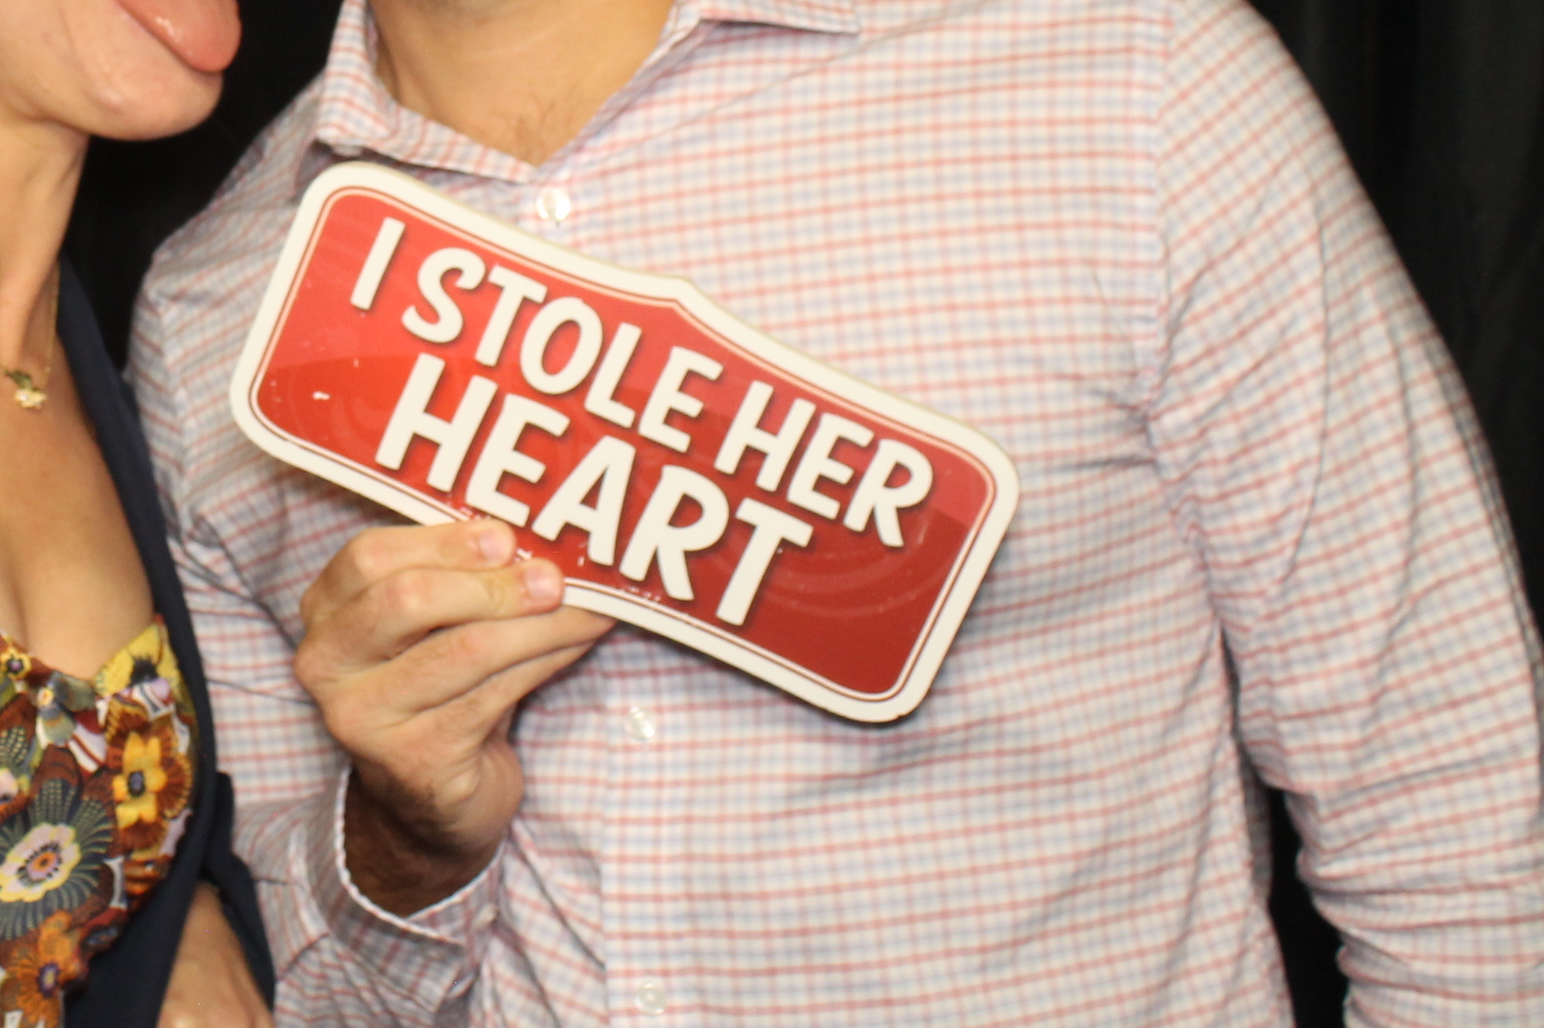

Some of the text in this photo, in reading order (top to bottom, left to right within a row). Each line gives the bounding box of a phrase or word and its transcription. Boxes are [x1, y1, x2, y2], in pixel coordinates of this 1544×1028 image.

[350, 217, 934, 548] I STOLE HER
[375, 353, 814, 627] HEART
